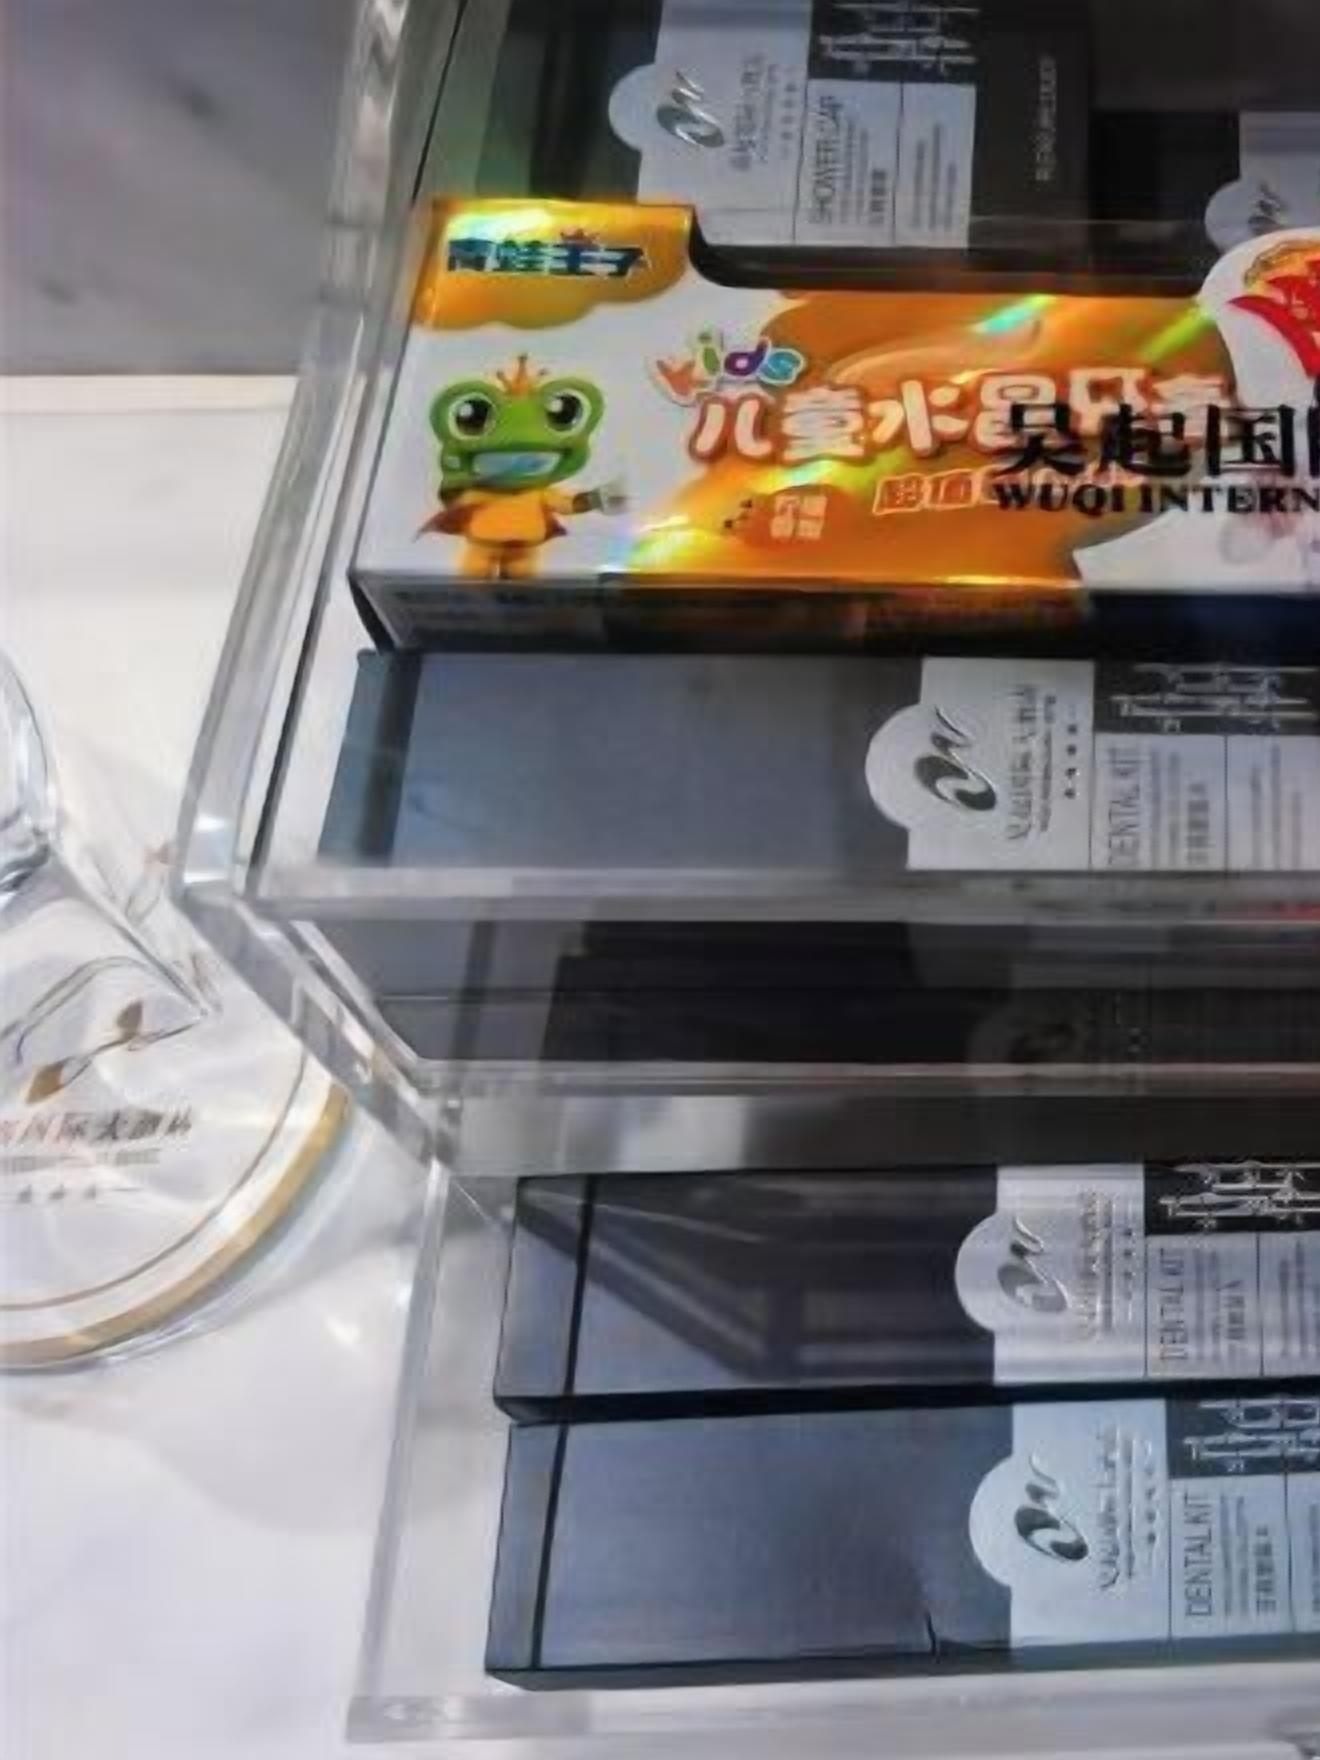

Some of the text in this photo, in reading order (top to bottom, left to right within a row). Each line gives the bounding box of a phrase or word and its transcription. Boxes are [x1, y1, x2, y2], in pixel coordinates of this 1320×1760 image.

[993, 484, 1125, 517] WUQI
[1108, 784, 1141, 865] DENTAL
[1160, 1281, 1189, 1361] DENTAL
[1183, 1492, 1213, 1618] DENTAL KIT
